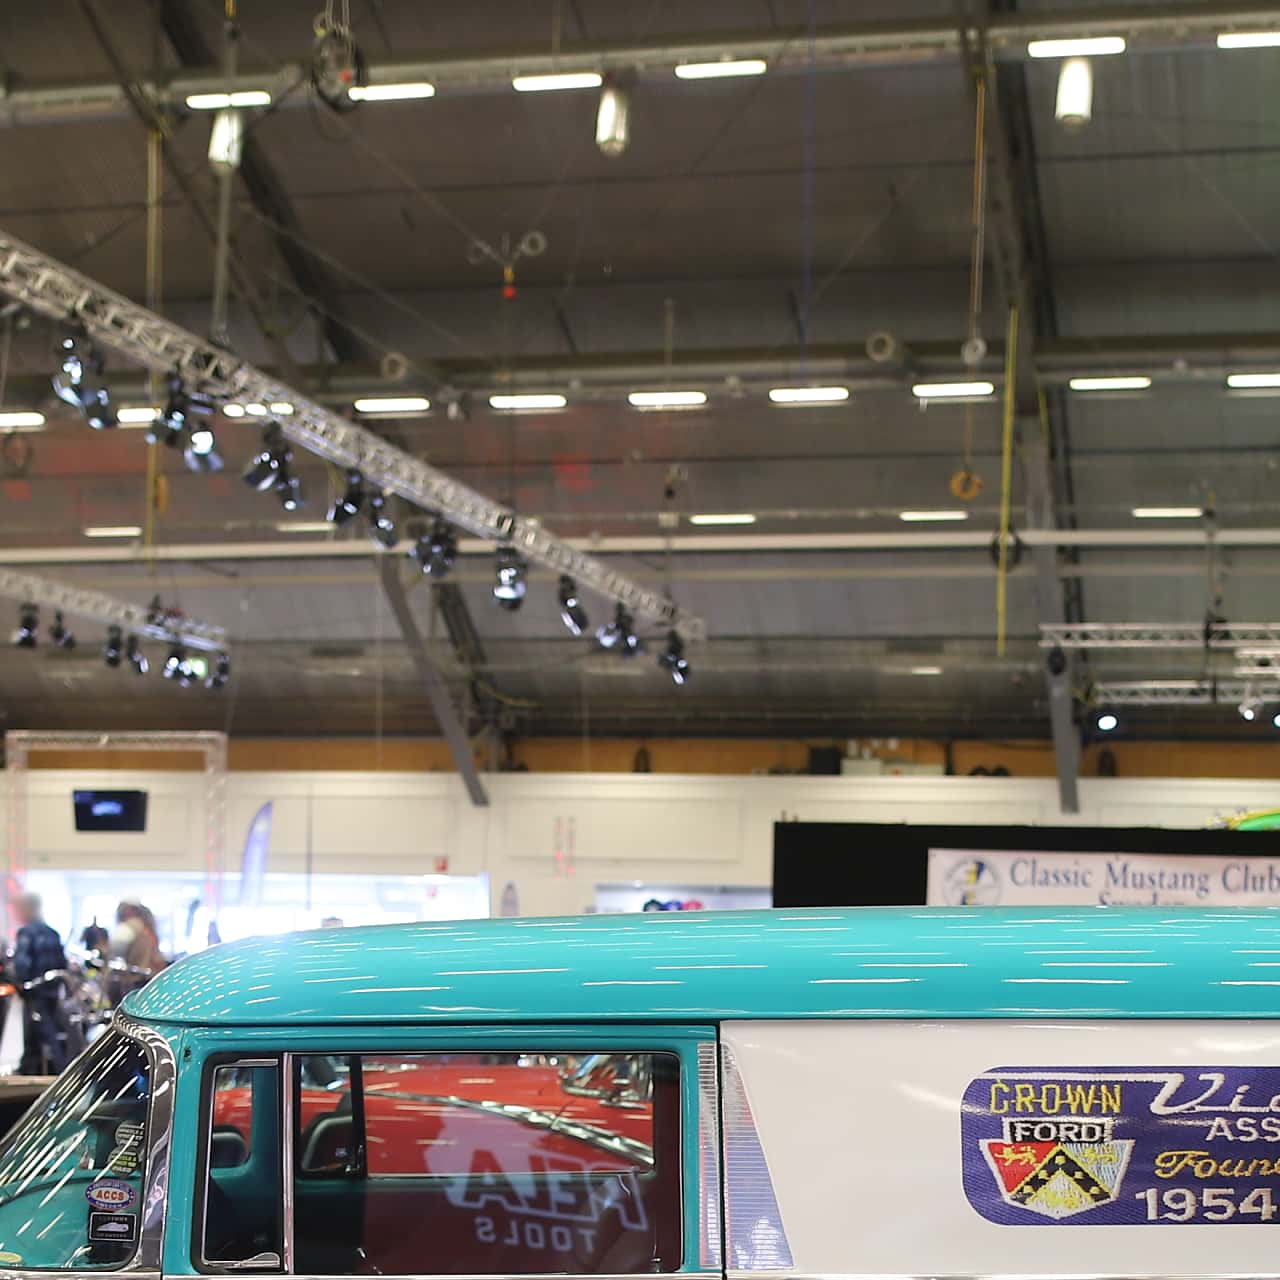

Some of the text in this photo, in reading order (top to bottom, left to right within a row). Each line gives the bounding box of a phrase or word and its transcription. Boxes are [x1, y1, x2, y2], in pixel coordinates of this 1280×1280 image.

[1009, 859, 1092, 889] Classic
[1104, 862, 1210, 896] Mustang
[989, 1079, 1121, 1115] CROWN
[1013, 1121, 1102, 1143] FORD
[96, 1190, 124, 1200] ACCS
[1135, 1186, 1278, 1221] 1954
